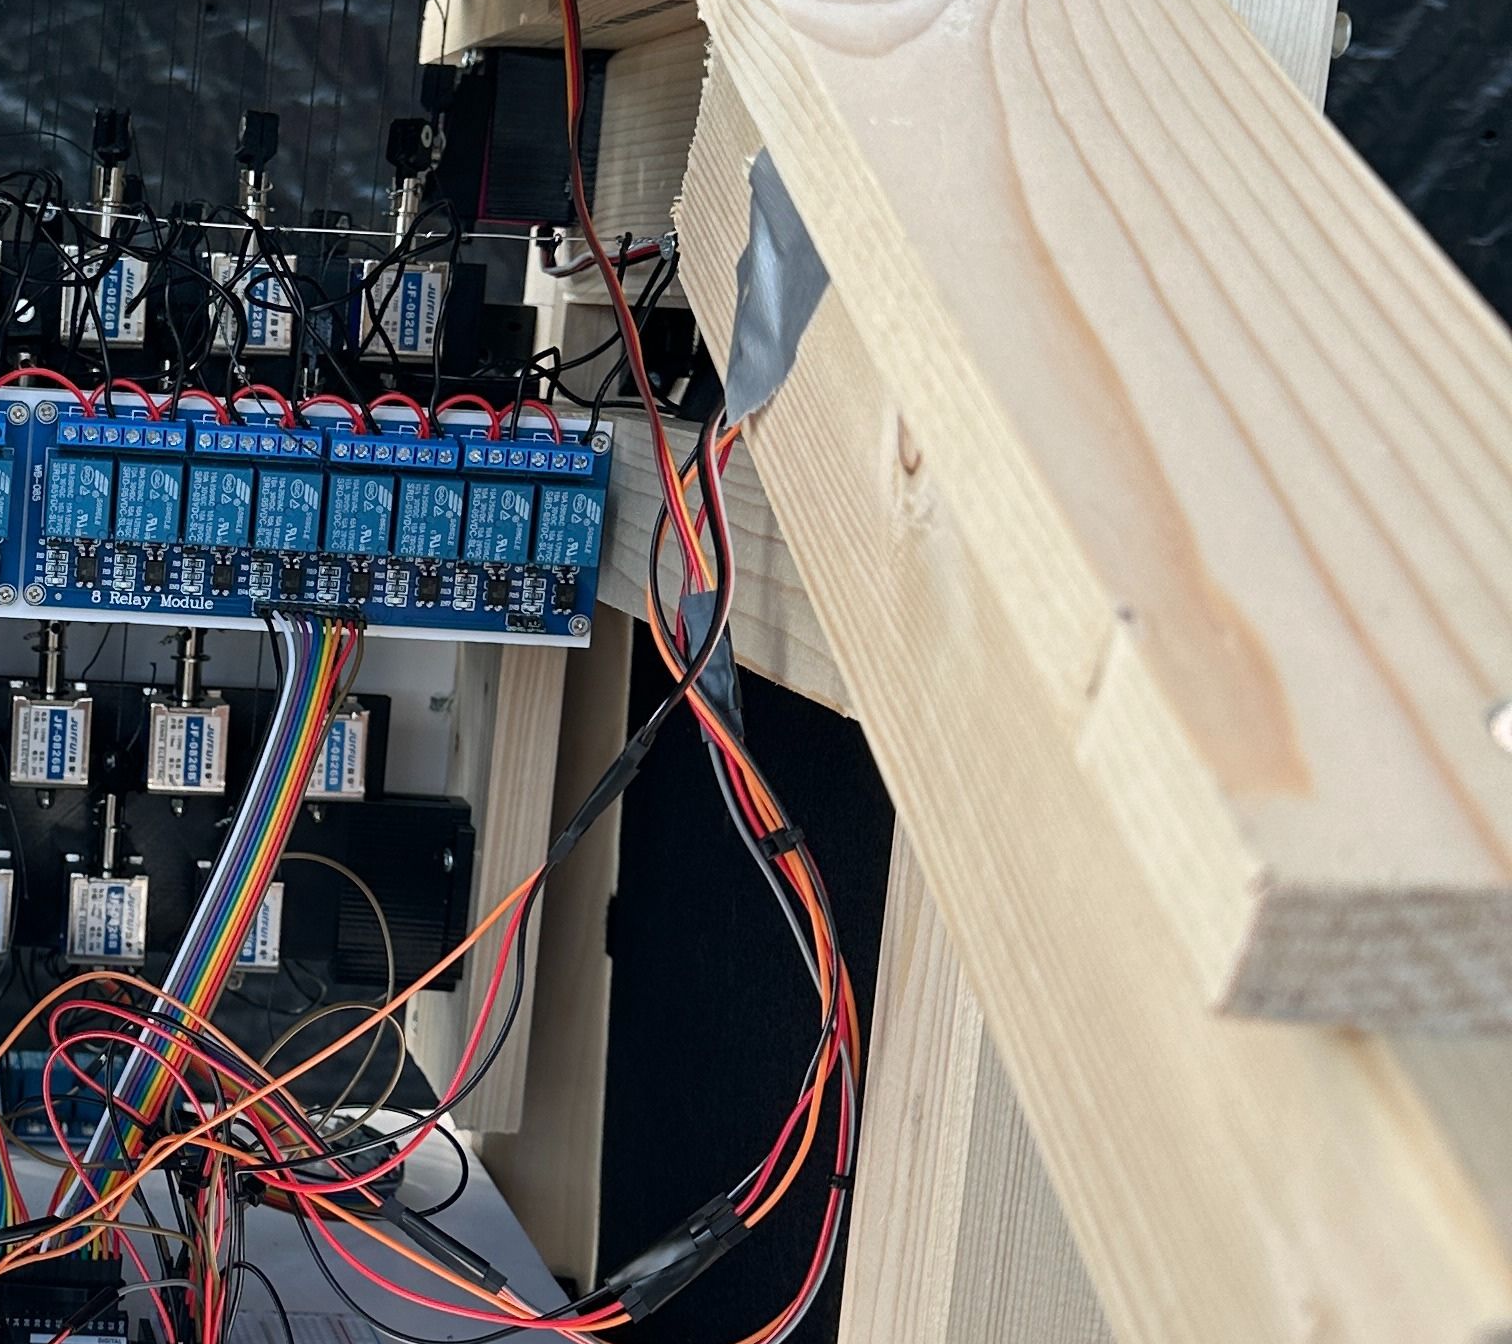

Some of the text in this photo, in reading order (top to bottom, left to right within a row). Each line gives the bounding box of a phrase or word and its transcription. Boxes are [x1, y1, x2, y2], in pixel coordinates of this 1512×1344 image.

[404, 282, 416, 345] JF-0826B
[91, 590, 214, 610] 8 Relay Module
[51, 715, 63, 774] JF-0826B
[187, 723, 199, 781] JF-0826B
[329, 727, 341, 785] JF-0826B
